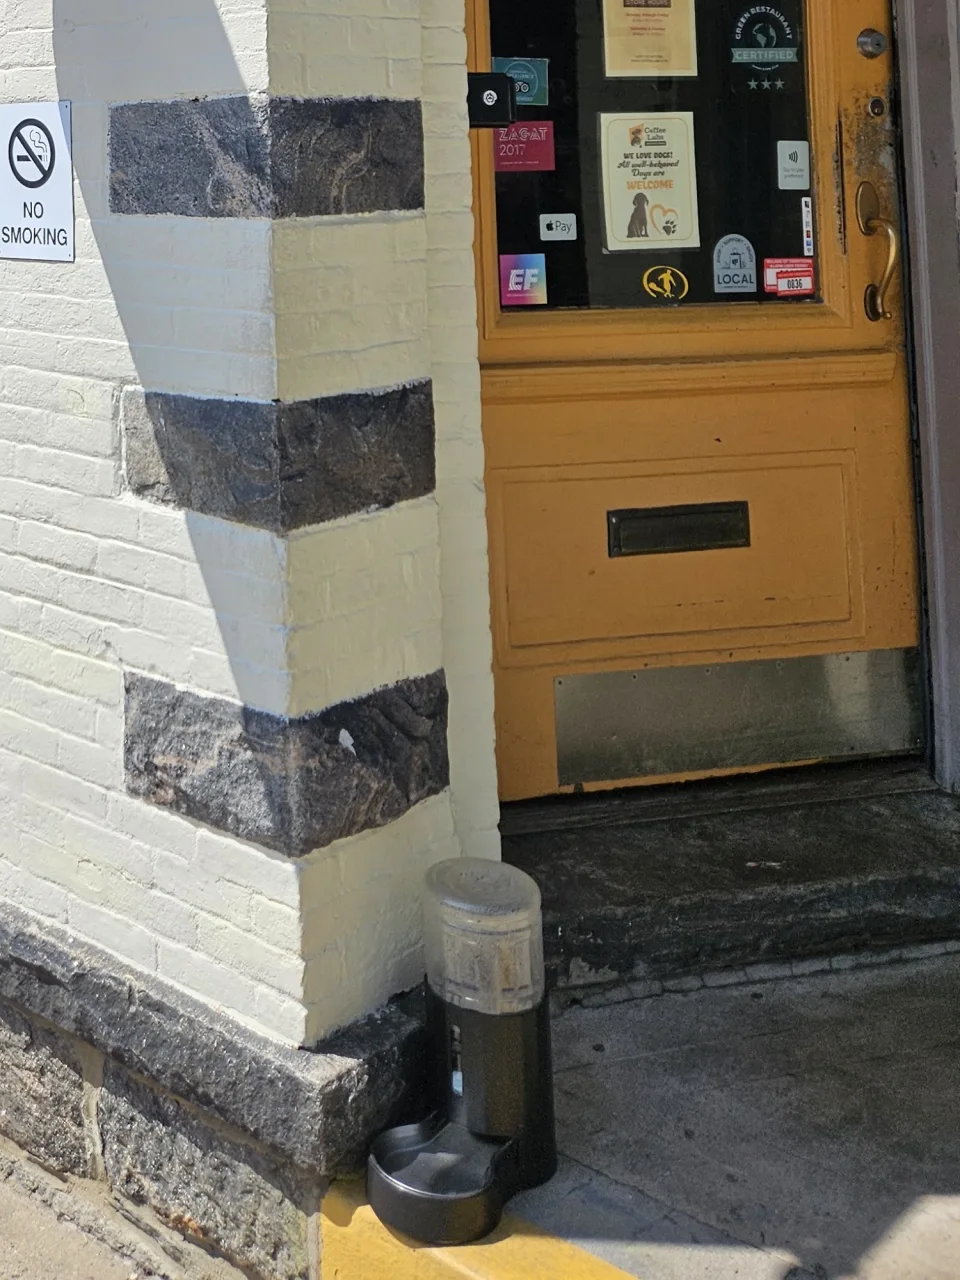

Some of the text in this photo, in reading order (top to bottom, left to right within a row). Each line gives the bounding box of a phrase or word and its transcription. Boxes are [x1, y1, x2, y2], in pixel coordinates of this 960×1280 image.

[735, 5, 793, 40] GREEN RESTAURANT
[735, 50, 794, 60] CERTIFIED
[499, 127, 548, 142] ZAGAT
[500, 143, 527, 156] 2017
[617, 160, 631, 169] All
[631, 168, 652, 180] Dogs
[626, 180, 675, 191] WELCOME
[23, 201, 44, 219] NO
[555, 220, 573, 235] Pay
[1, 225, 69, 246] SMOKING
[508, 268, 541, 291] EF
[717, 273, 755, 285] LOCAL
